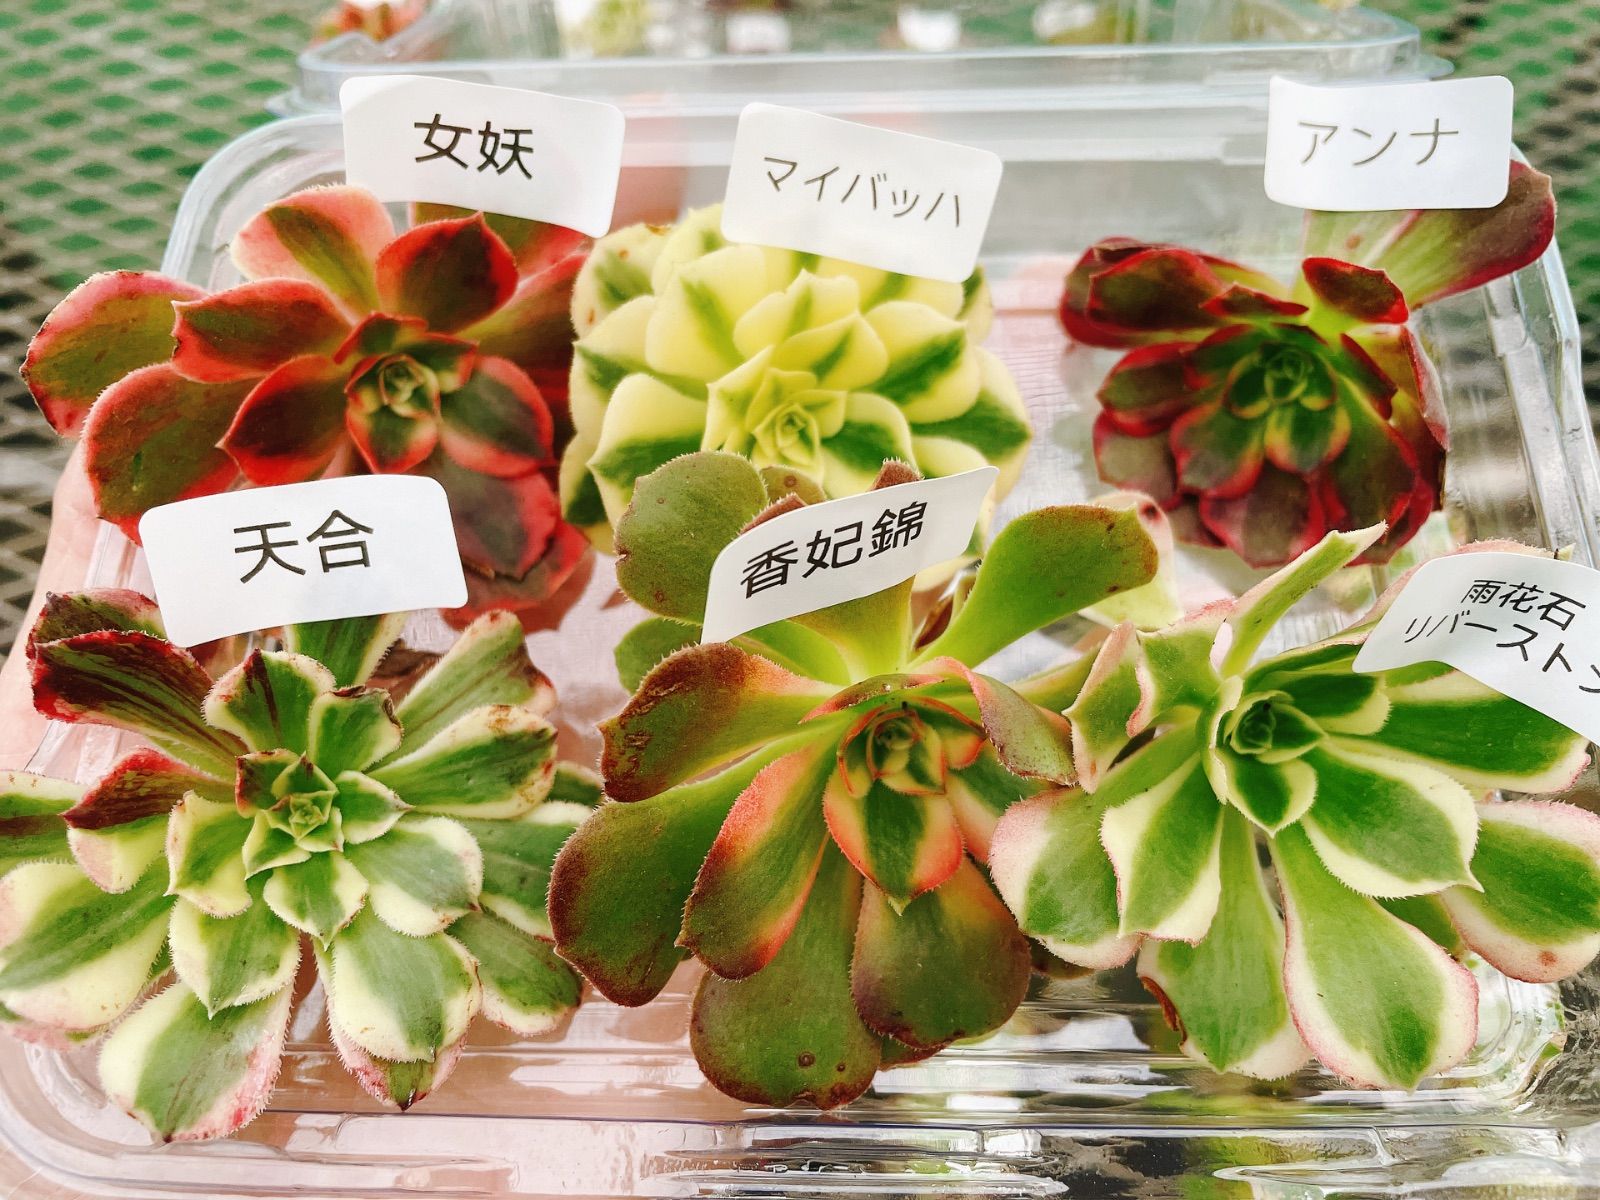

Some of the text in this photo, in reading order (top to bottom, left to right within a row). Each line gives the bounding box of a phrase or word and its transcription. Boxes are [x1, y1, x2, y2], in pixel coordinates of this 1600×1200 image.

[414, 113, 534, 180] 女妖
[1298, 118, 1459, 166] アンナ
[763, 156, 961, 227] マイバッハ
[233, 509, 374, 584] 天合
[740, 501, 928, 599] 香妃錦
[1460, 579, 1587, 632] 雨花石
